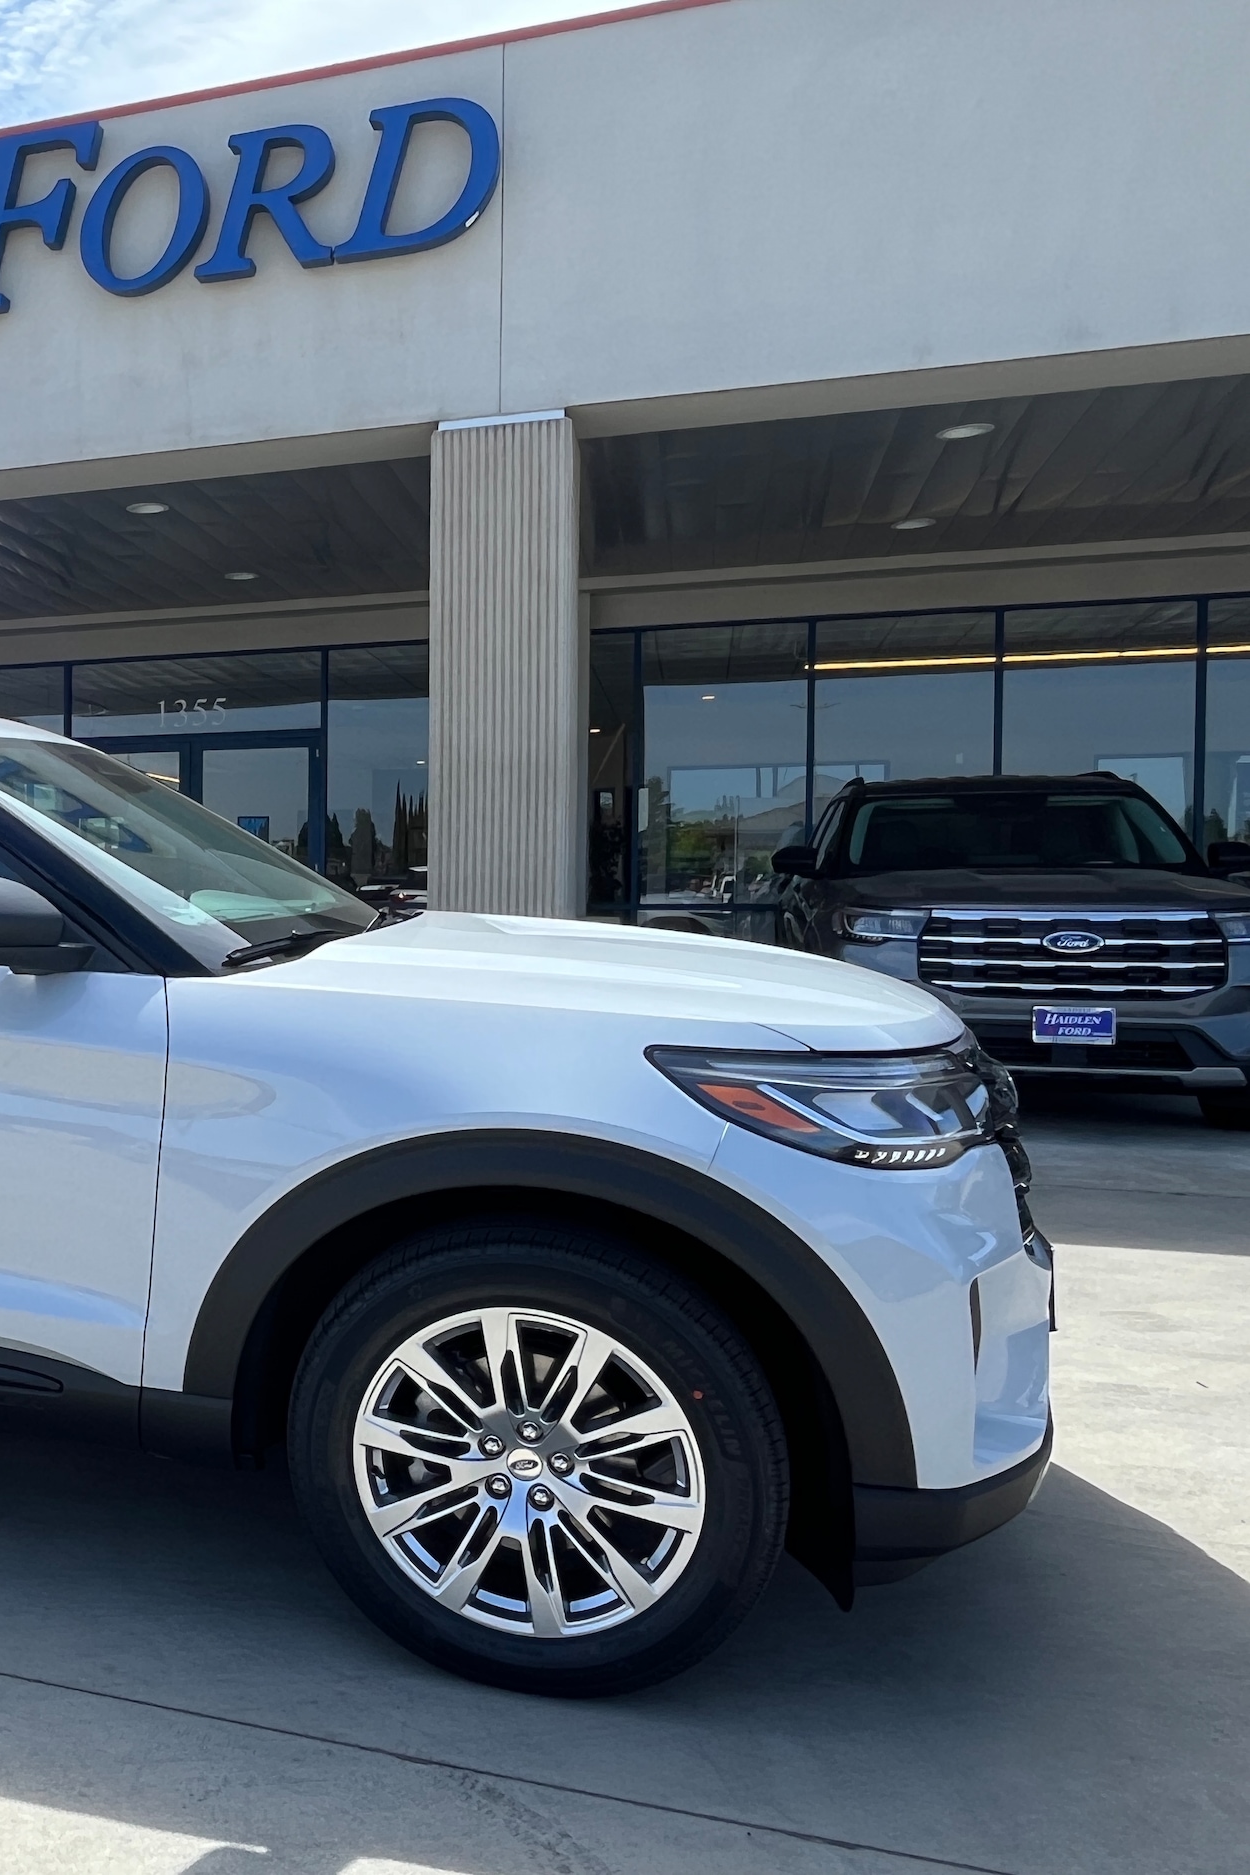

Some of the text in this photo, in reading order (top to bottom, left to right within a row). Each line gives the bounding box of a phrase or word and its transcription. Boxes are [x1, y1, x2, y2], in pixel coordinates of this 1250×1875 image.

[157, 697, 228, 728] 1355
[1056, 934, 1090, 948] Ford
[1043, 1013, 1102, 1025] HAIDLEN
[1057, 1026, 1092, 1036] FORD
